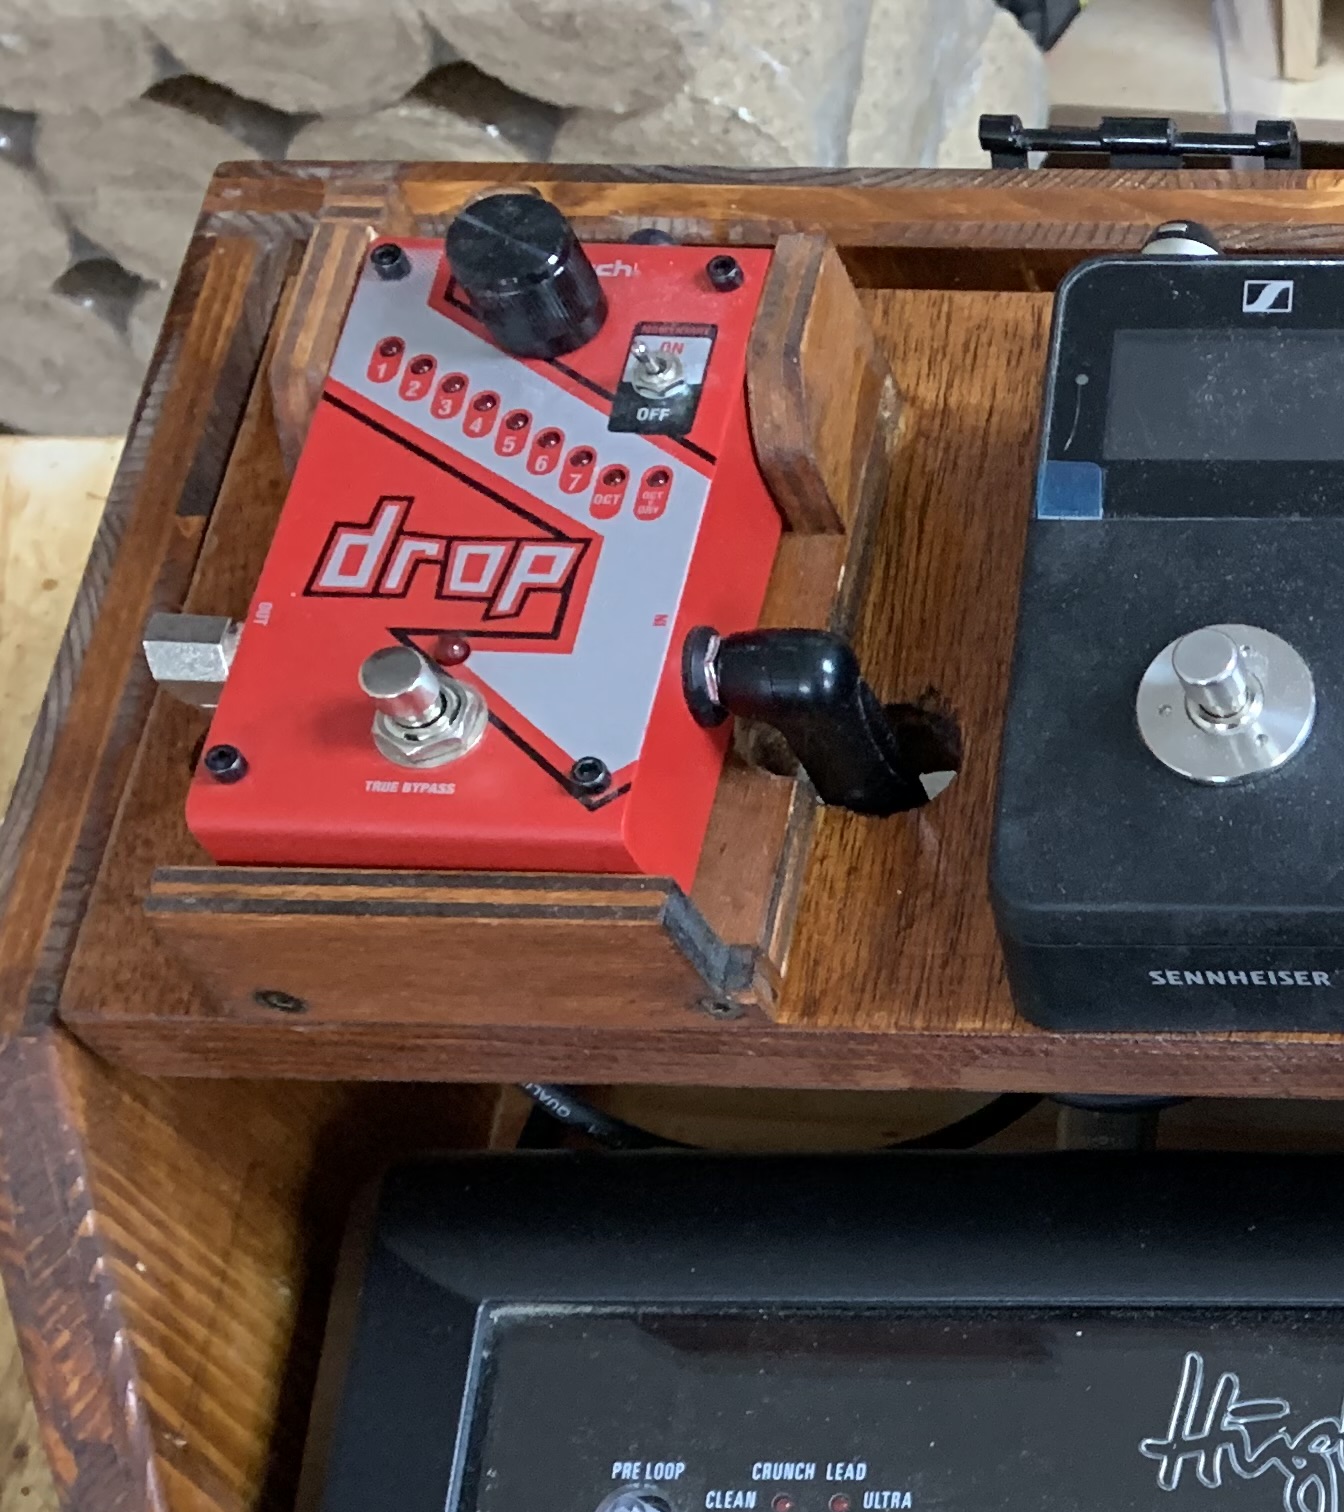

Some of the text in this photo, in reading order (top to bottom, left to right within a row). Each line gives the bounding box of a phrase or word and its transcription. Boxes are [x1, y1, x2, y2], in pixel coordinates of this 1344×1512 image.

[376, 362, 389, 378] 1
[405, 380, 421, 397] 2
[437, 398, 453, 415] 3
[635, 407, 671, 422] OFF
[468, 417, 483, 433] 4
[501, 436, 517, 453] 5
[534, 455, 548, 472] 6
[568, 473, 583, 491] 7
[592, 493, 621, 506] OCT
[303, 495, 590, 621] drop
[364, 780, 457, 795] TRUE BYPASS
[1149, 967, 1332, 989] SENNHEISER
[611, 1461, 686, 1481] PRE LOOP
[751, 1461, 816, 1482] CRUNCH
[825, 1462, 868, 1482] LEAD
[704, 1490, 757, 1510] CLEAN
[862, 1491, 914, 1511] ULTRA
